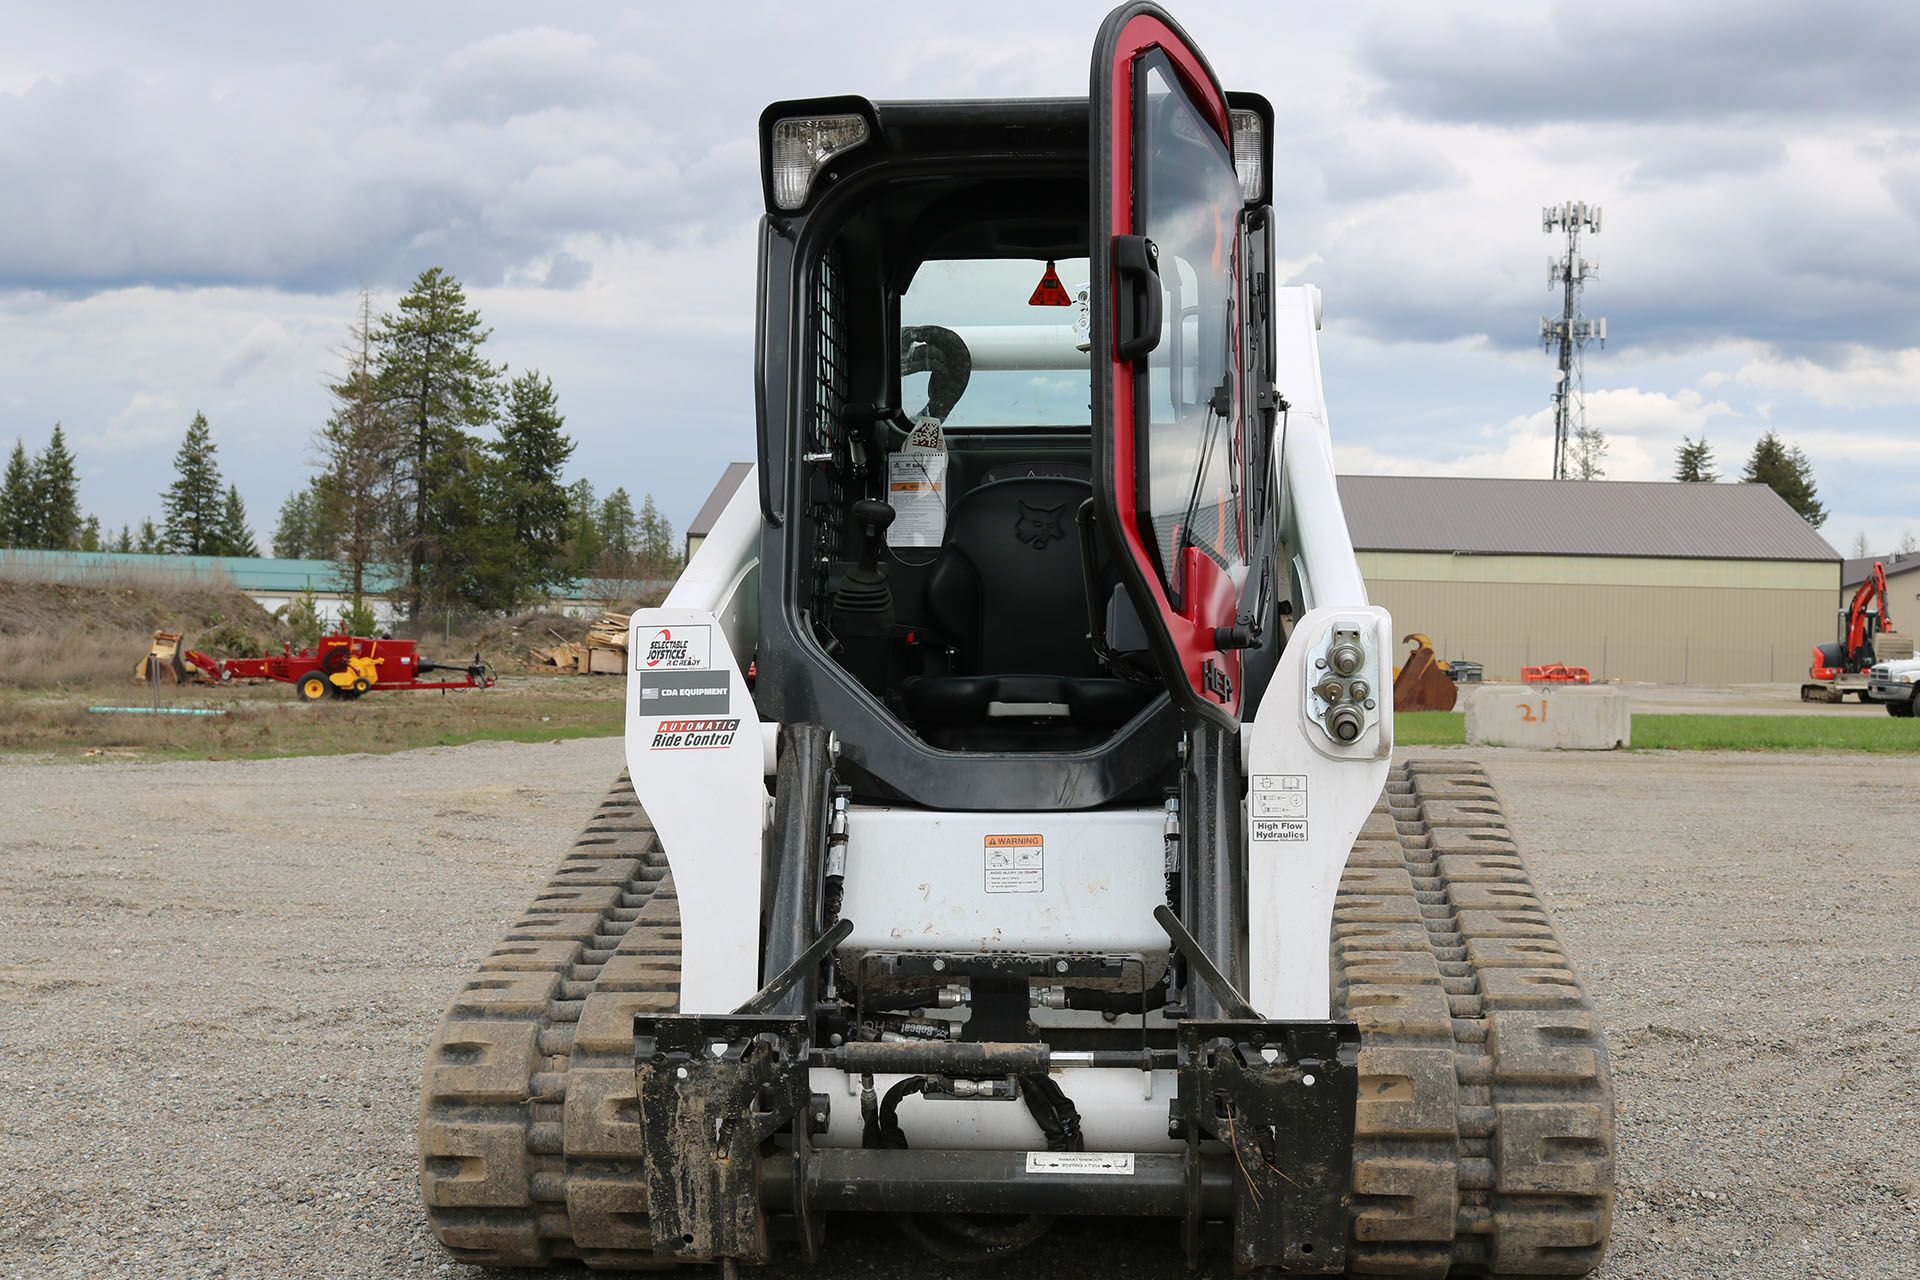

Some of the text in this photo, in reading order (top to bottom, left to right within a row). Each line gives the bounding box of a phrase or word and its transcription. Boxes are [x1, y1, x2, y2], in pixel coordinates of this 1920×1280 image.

[650, 640, 688, 649] SELECTABLE
[647, 649, 686, 660] JOYSTICKS
[661, 688, 728, 697] CDA EQUIPMENT
[1514, 699, 1548, 723] 21
[660, 721, 735, 731] AUTOMATIC
[651, 732, 735, 747] Ride Control
[1257, 822, 1303, 831] High Flow
[1256, 831, 1305, 840] Hydraulics
[998, 837, 1039, 845] WARNING
[901, 1023, 934, 1036] Bobcat
